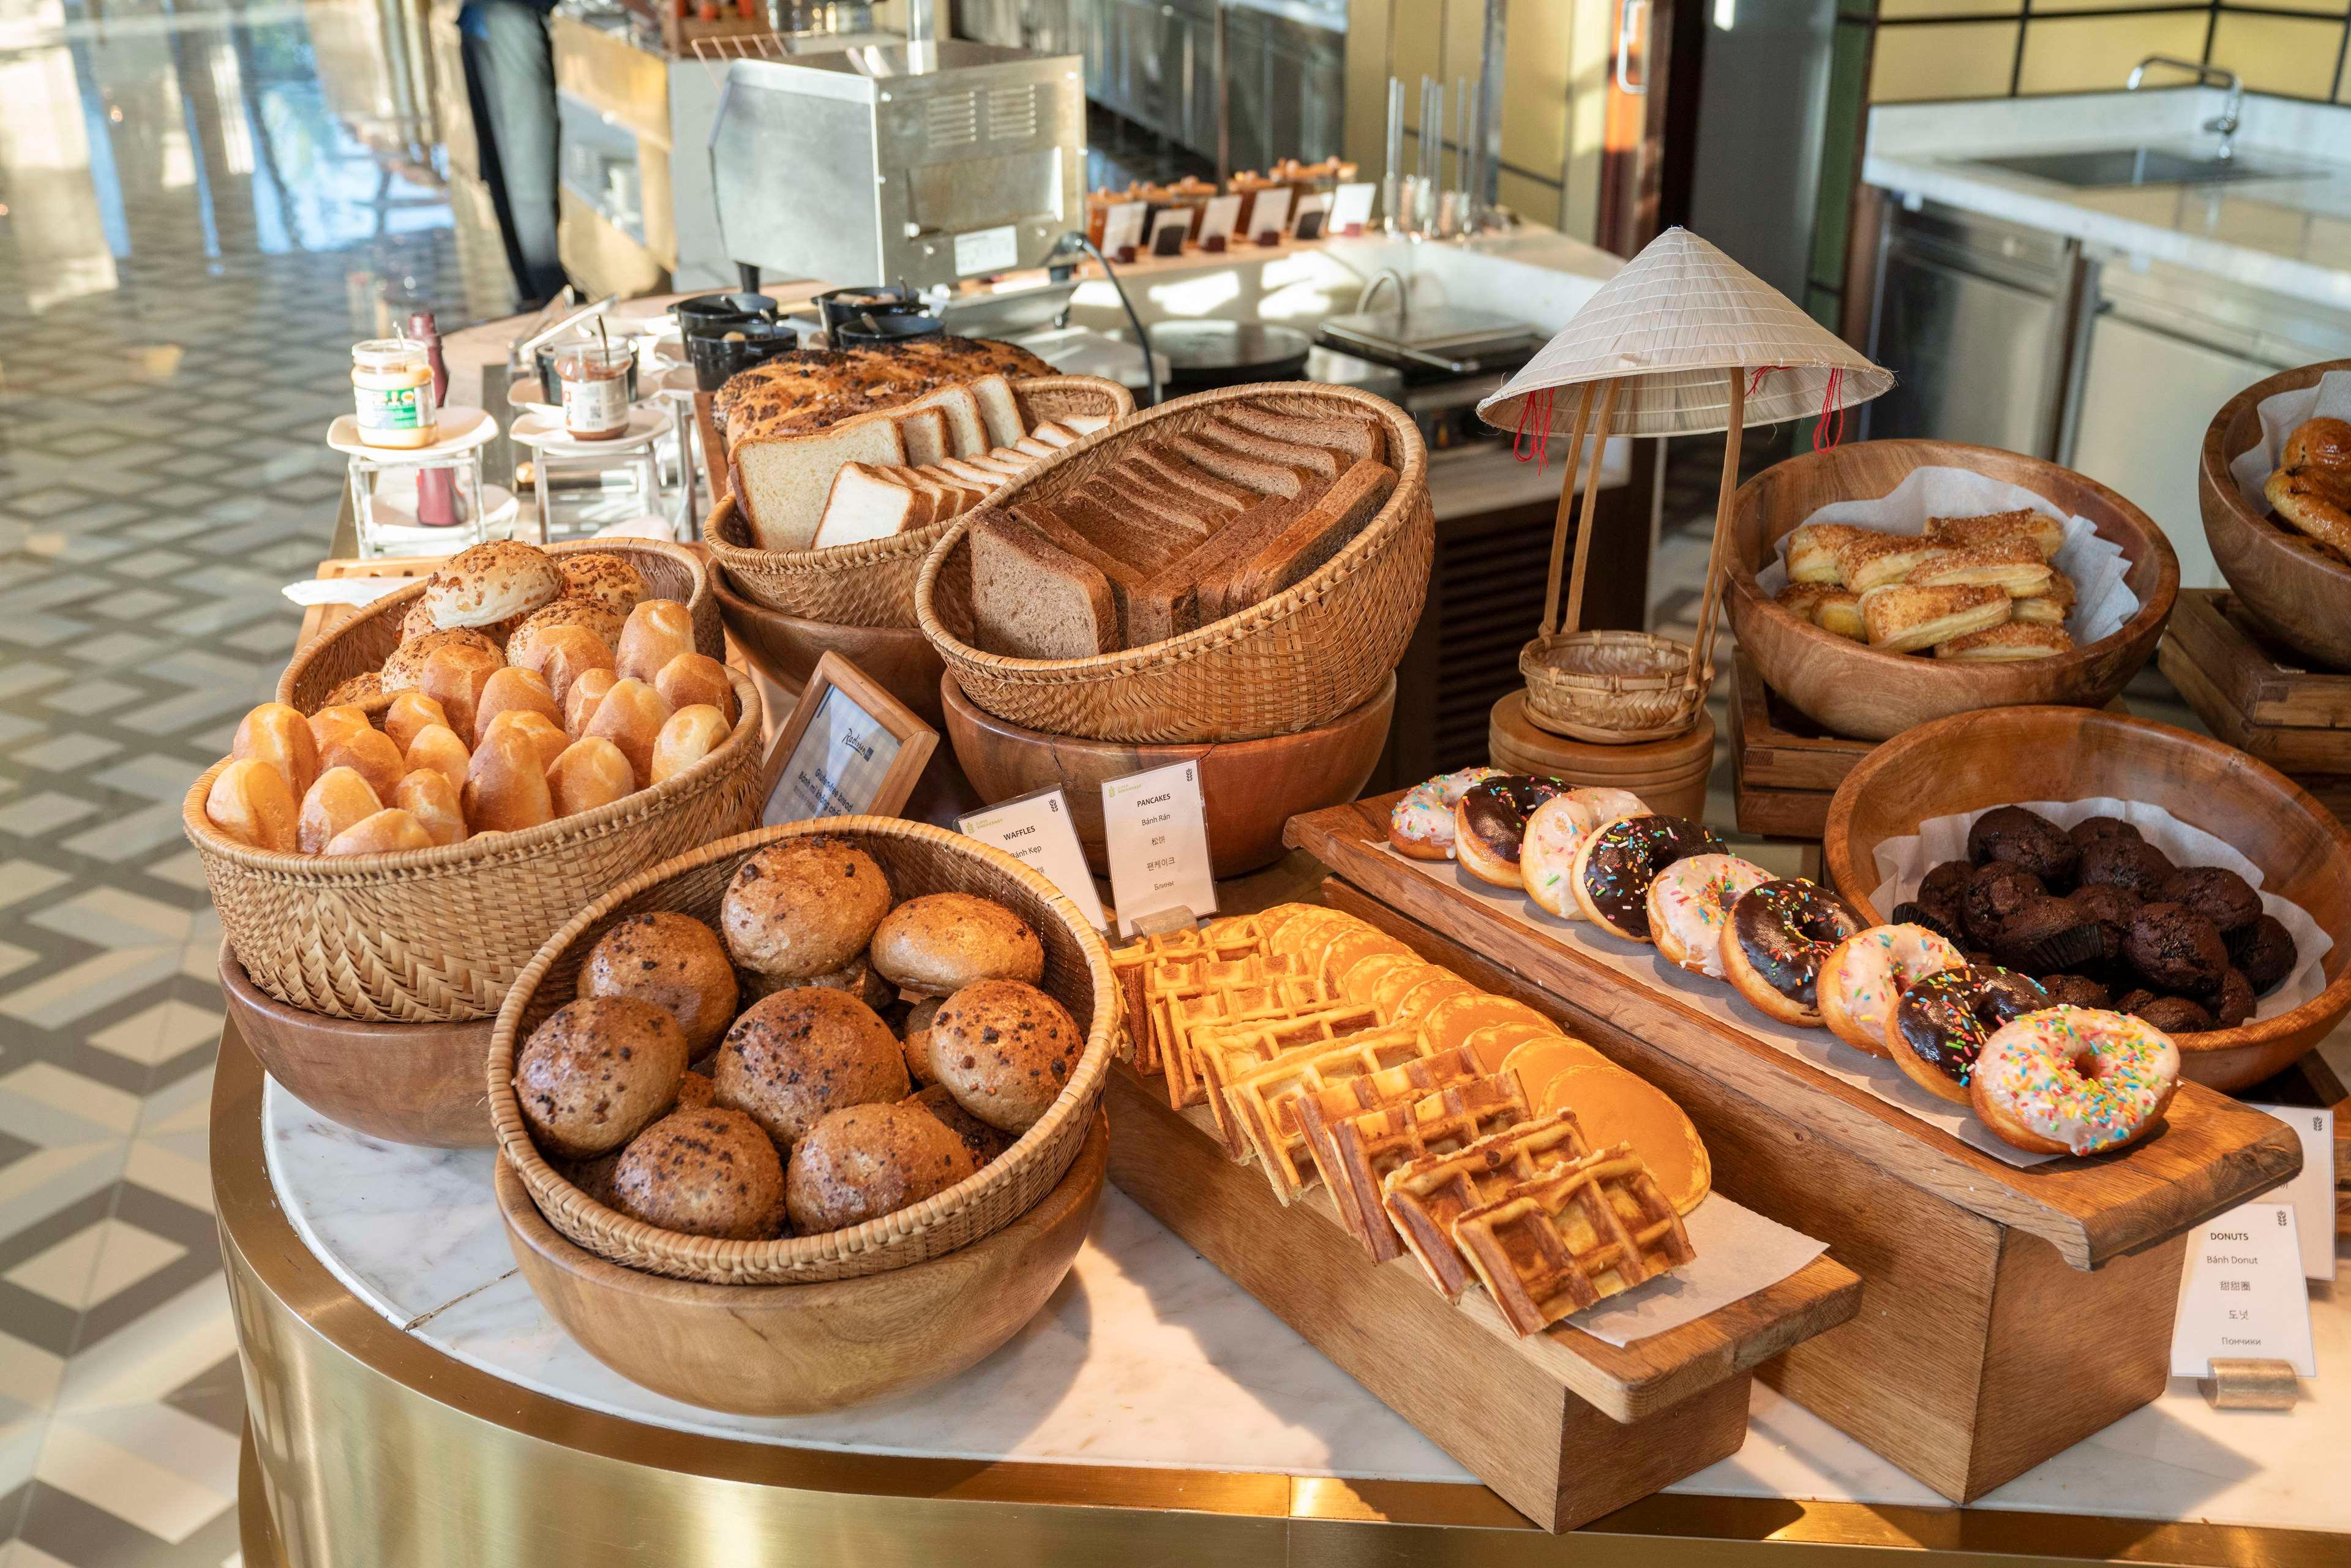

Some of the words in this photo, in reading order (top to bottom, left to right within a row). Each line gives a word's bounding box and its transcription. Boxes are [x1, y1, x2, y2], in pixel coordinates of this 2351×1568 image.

[842, 728, 866, 755] Radisson
[815, 768, 839, 797] Gluten-free
[838, 792, 853, 812] bread
[1137, 793, 1171, 808] PANCAKES
[1142, 816, 1158, 826] Bánh
[1158, 812, 1171, 822] Rán
[1003, 825, 1035, 841] WAFFLES
[1151, 835, 1166, 846] 松饼
[1028, 846, 1041, 854] Kẹp
[1147, 857, 1176, 871] 팬케이크
[1154, 881, 1174, 890] Блины
[2207, 1255, 2229, 1264] Bánh
[2231, 1256, 2258, 1264] Donut
[2219, 1281, 2251, 1291] 甜甜圈
[2228, 1310, 2249, 1320] 도넛
